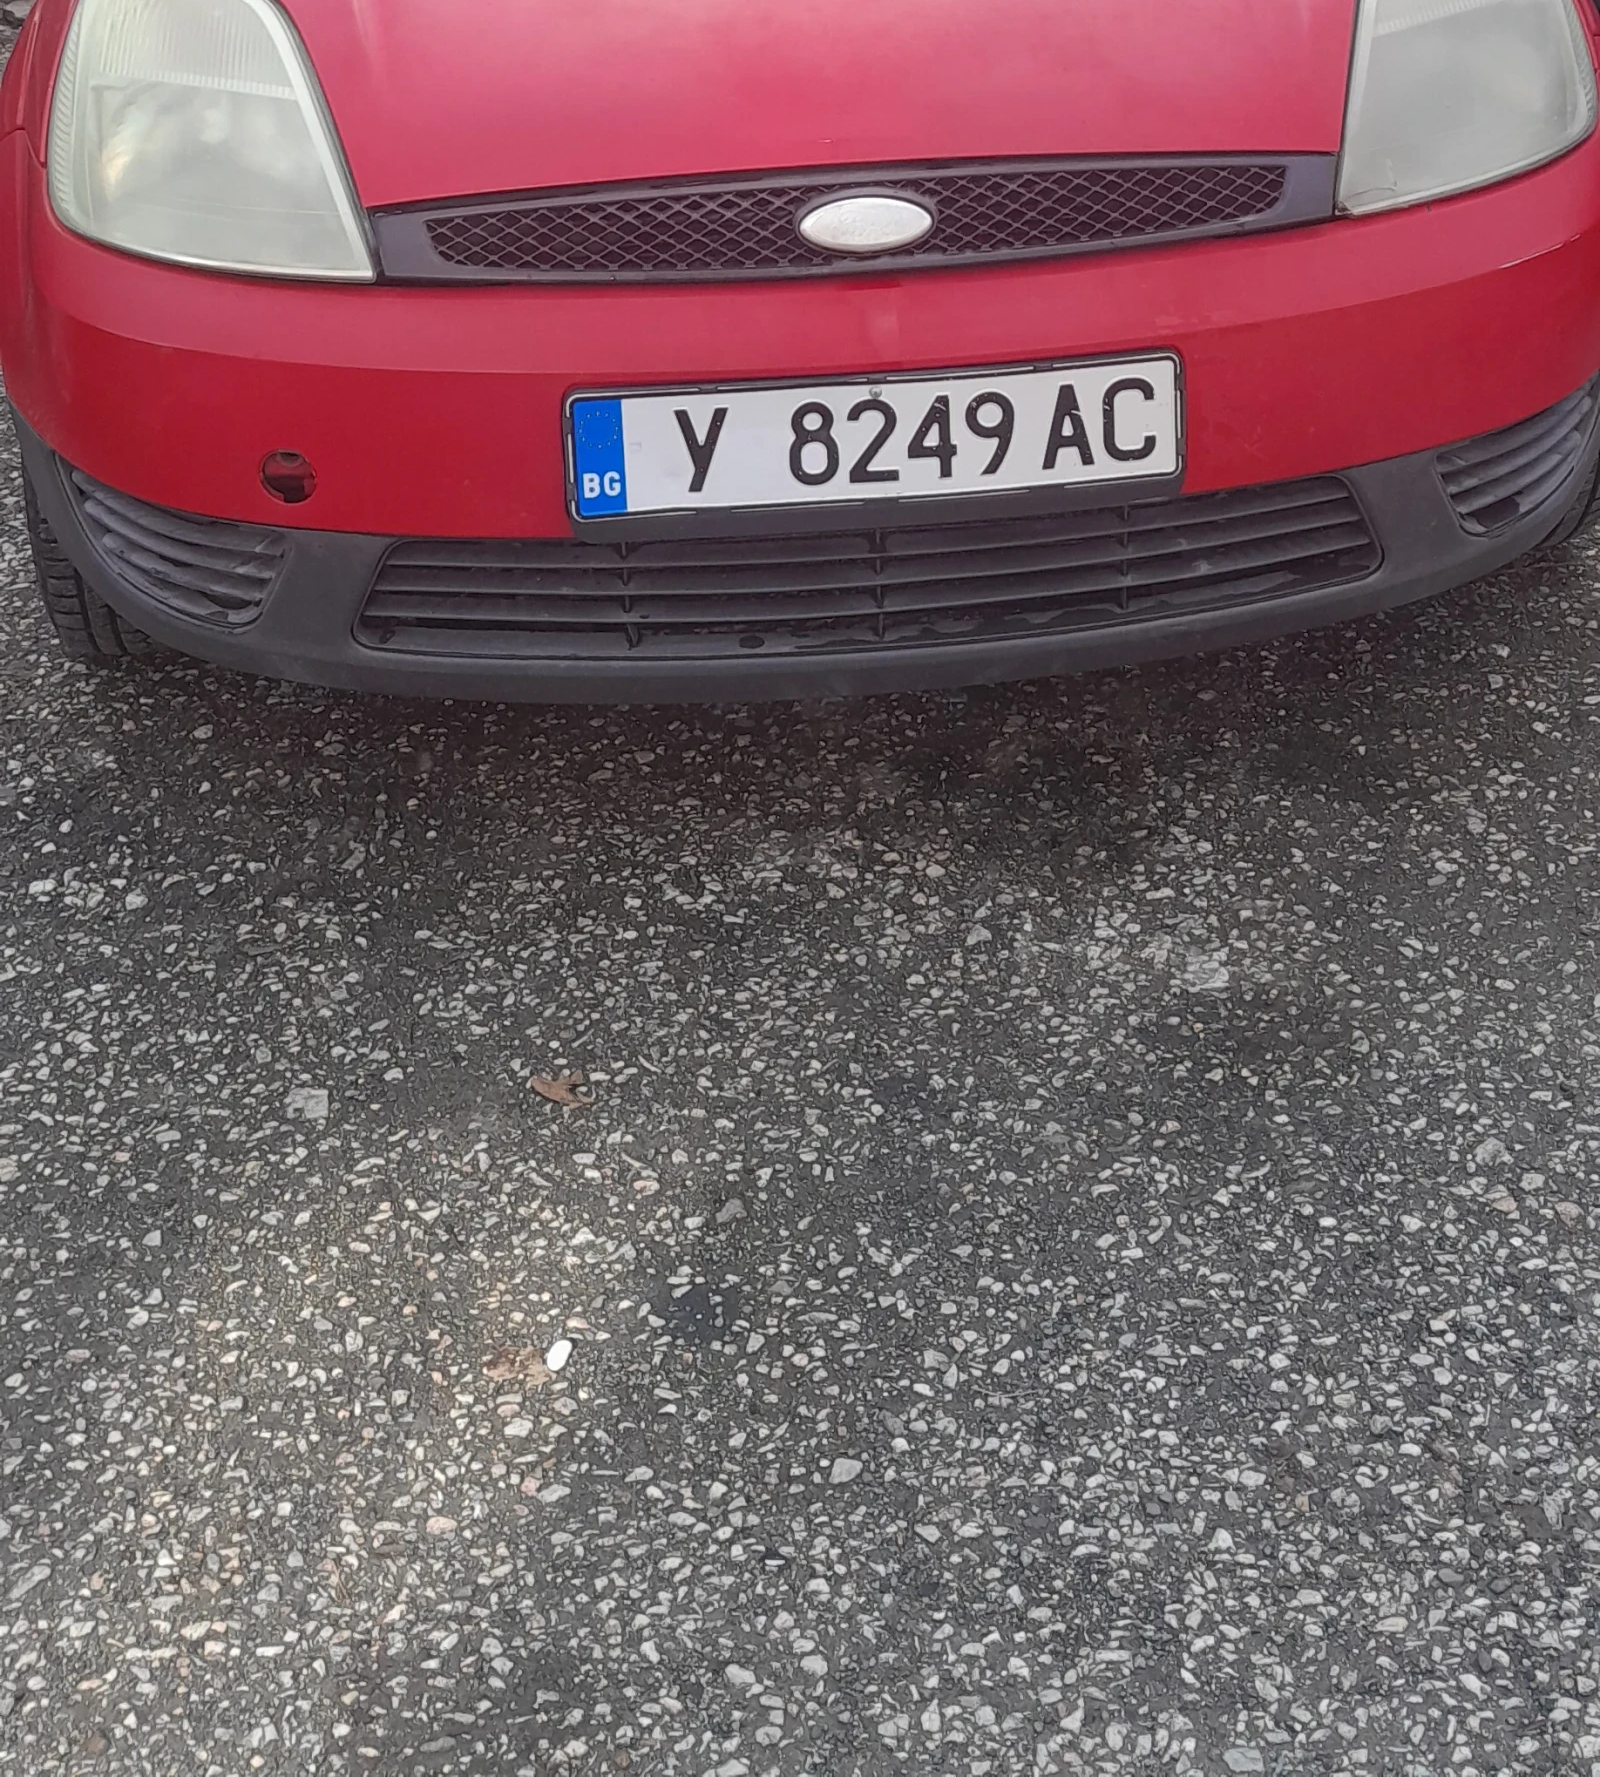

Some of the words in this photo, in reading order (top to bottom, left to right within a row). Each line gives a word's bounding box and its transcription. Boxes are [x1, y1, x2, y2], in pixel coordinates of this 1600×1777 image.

[674, 407, 729, 493] Y
[789, 391, 1015, 486] 8249
[1042, 377, 1156, 470] AC
[582, 470, 621, 499] BG
